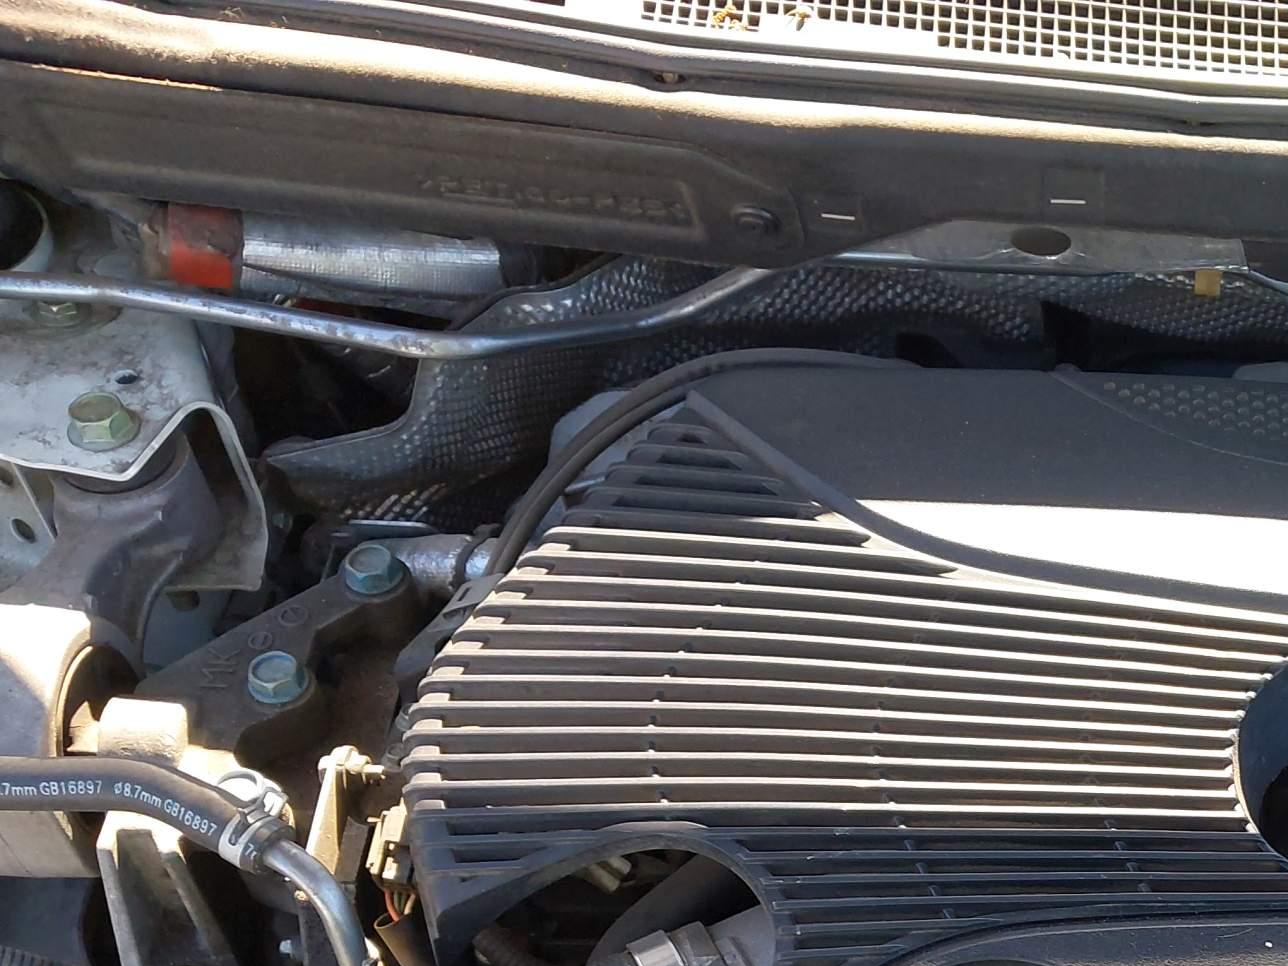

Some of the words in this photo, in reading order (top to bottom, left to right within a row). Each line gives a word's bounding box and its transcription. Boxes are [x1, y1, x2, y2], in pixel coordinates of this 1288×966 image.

[0, 782, 37, 796] .7mm
[39, 780, 103, 796] GB16897
[163, 799, 219, 837] GB16897
